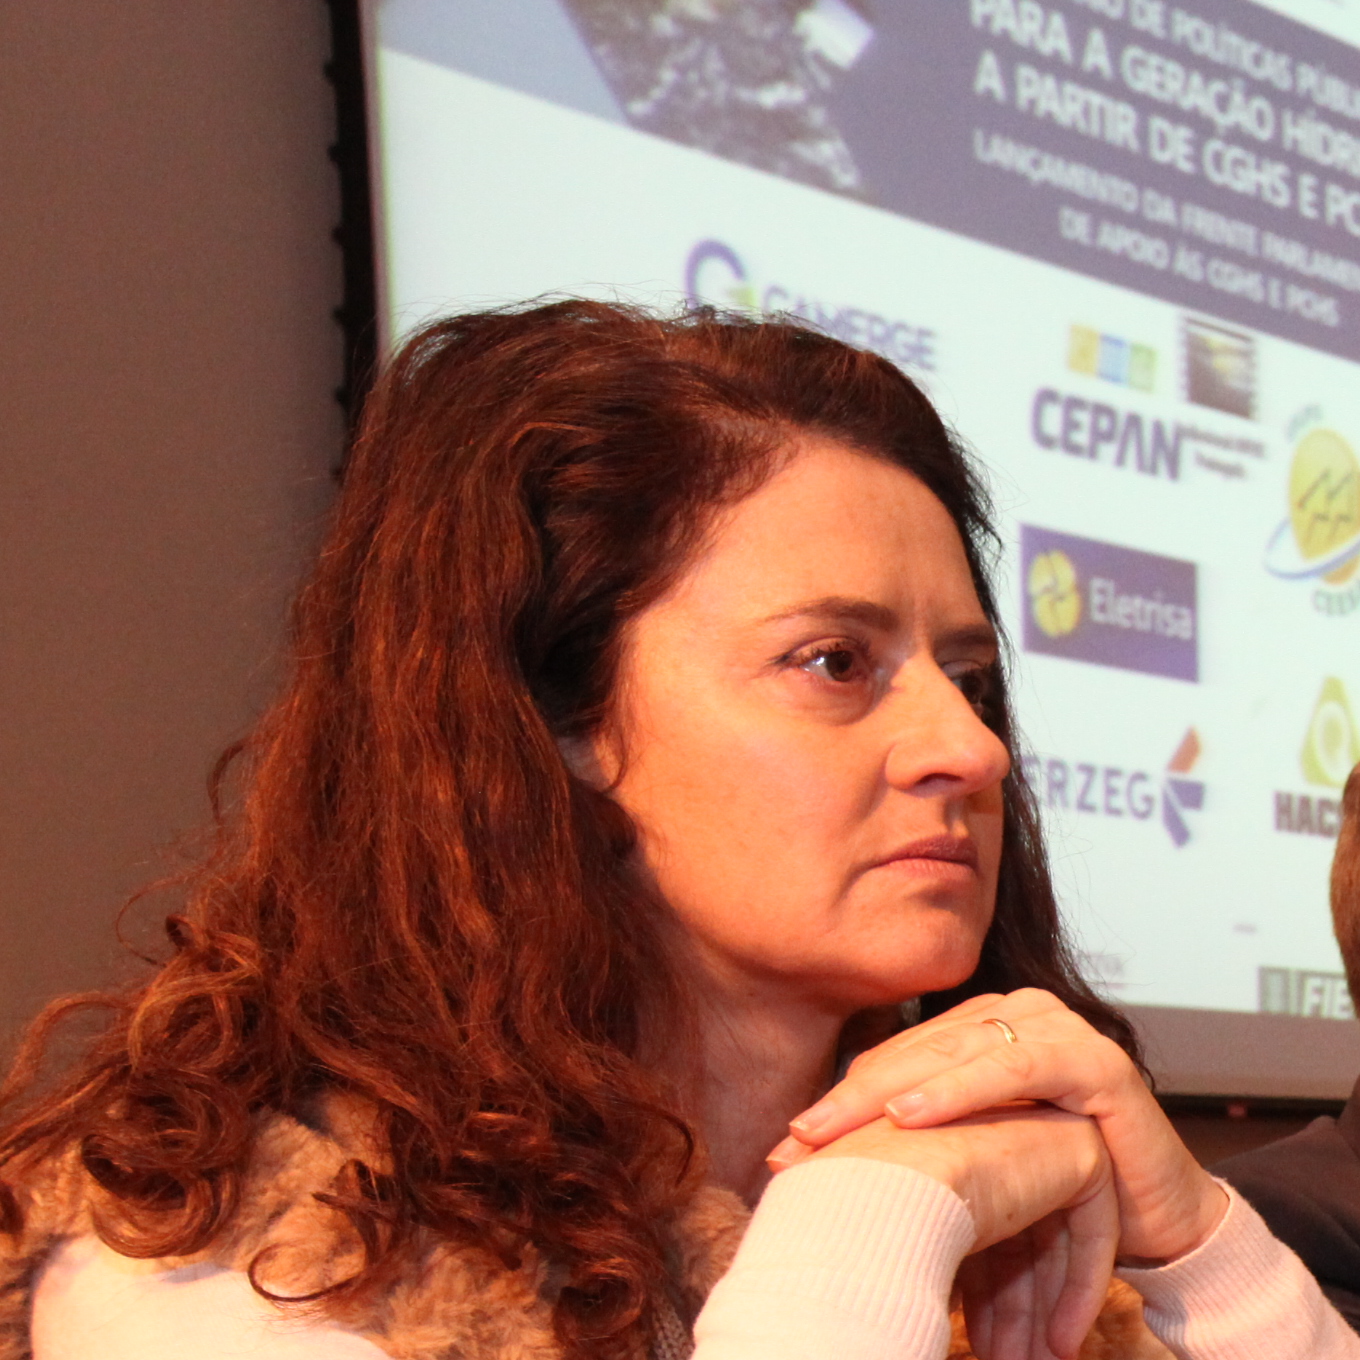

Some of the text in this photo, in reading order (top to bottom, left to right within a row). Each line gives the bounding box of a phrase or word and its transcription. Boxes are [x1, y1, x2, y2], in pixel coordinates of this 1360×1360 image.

[969, 0, 1073, 64] PARA
[1081, 27, 1113, 80] A
[1121, 44, 1276, 142] GERAÇÃO
[1129, 0, 1167, 39] DE
[1171, 8, 1293, 91] POLÍTICAS
[973, 49, 1006, 100] A
[1014, 62, 1140, 153] PARTIR
[1148, 115, 1197, 174] DE
[1201, 138, 1292, 208] CGHS
[1297, 173, 1319, 219] E
[973, 128, 1140, 213] LANÇAMENTO
[1142, 187, 1178, 227] DA
[1179, 201, 1258, 256] FRENTE
[1058, 206, 1092, 246] DE
[1098, 220, 1170, 270] APOIO
[1205, 256, 1266, 302] CGHS
[1268, 277, 1281, 309] E
[1089, 577, 1193, 640] Eletrisa
[1274, 790, 1343, 839] HAC
